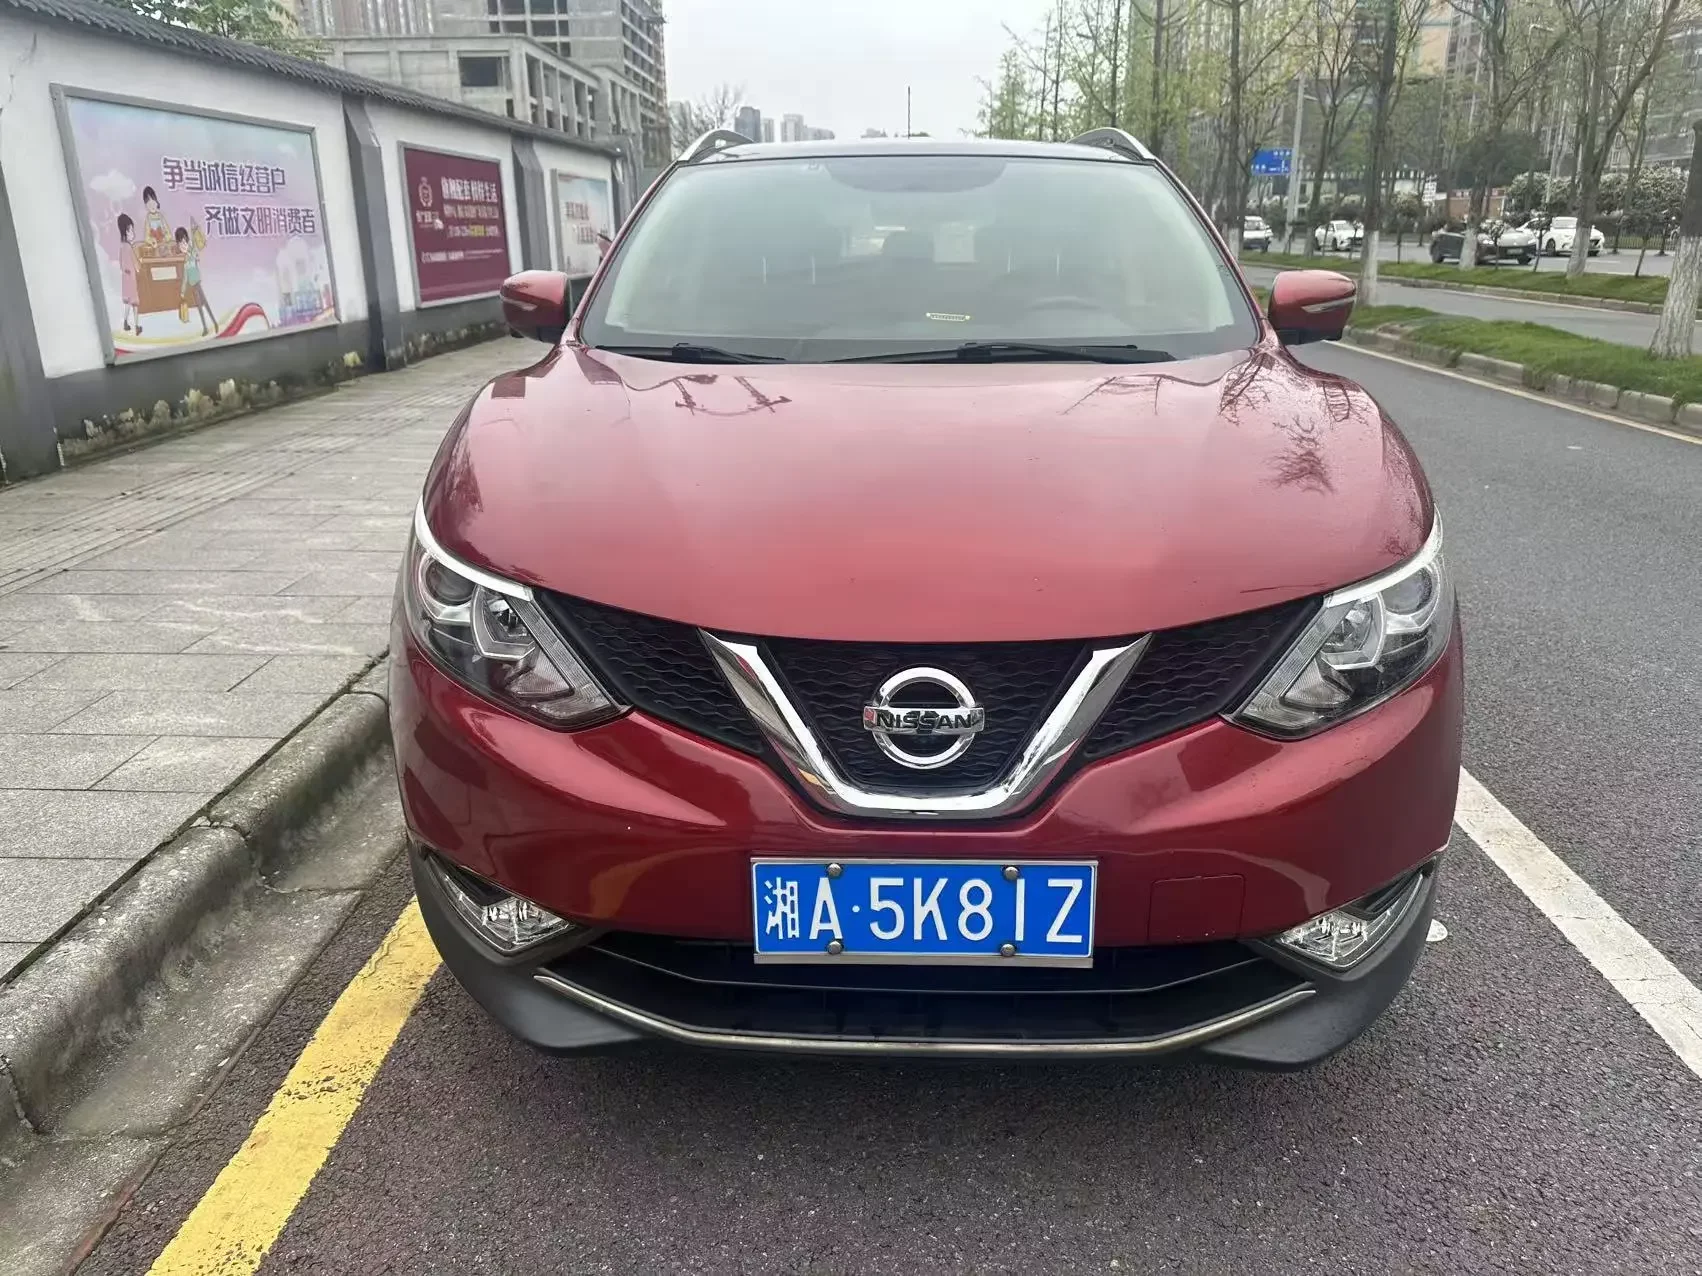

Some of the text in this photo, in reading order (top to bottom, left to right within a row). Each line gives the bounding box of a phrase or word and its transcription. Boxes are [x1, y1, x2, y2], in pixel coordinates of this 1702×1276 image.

[162, 157, 286, 194] 争当诚信经营户
[204, 205, 316, 236] 齐做文明消费者
[876, 709, 972, 730] NISSAN
